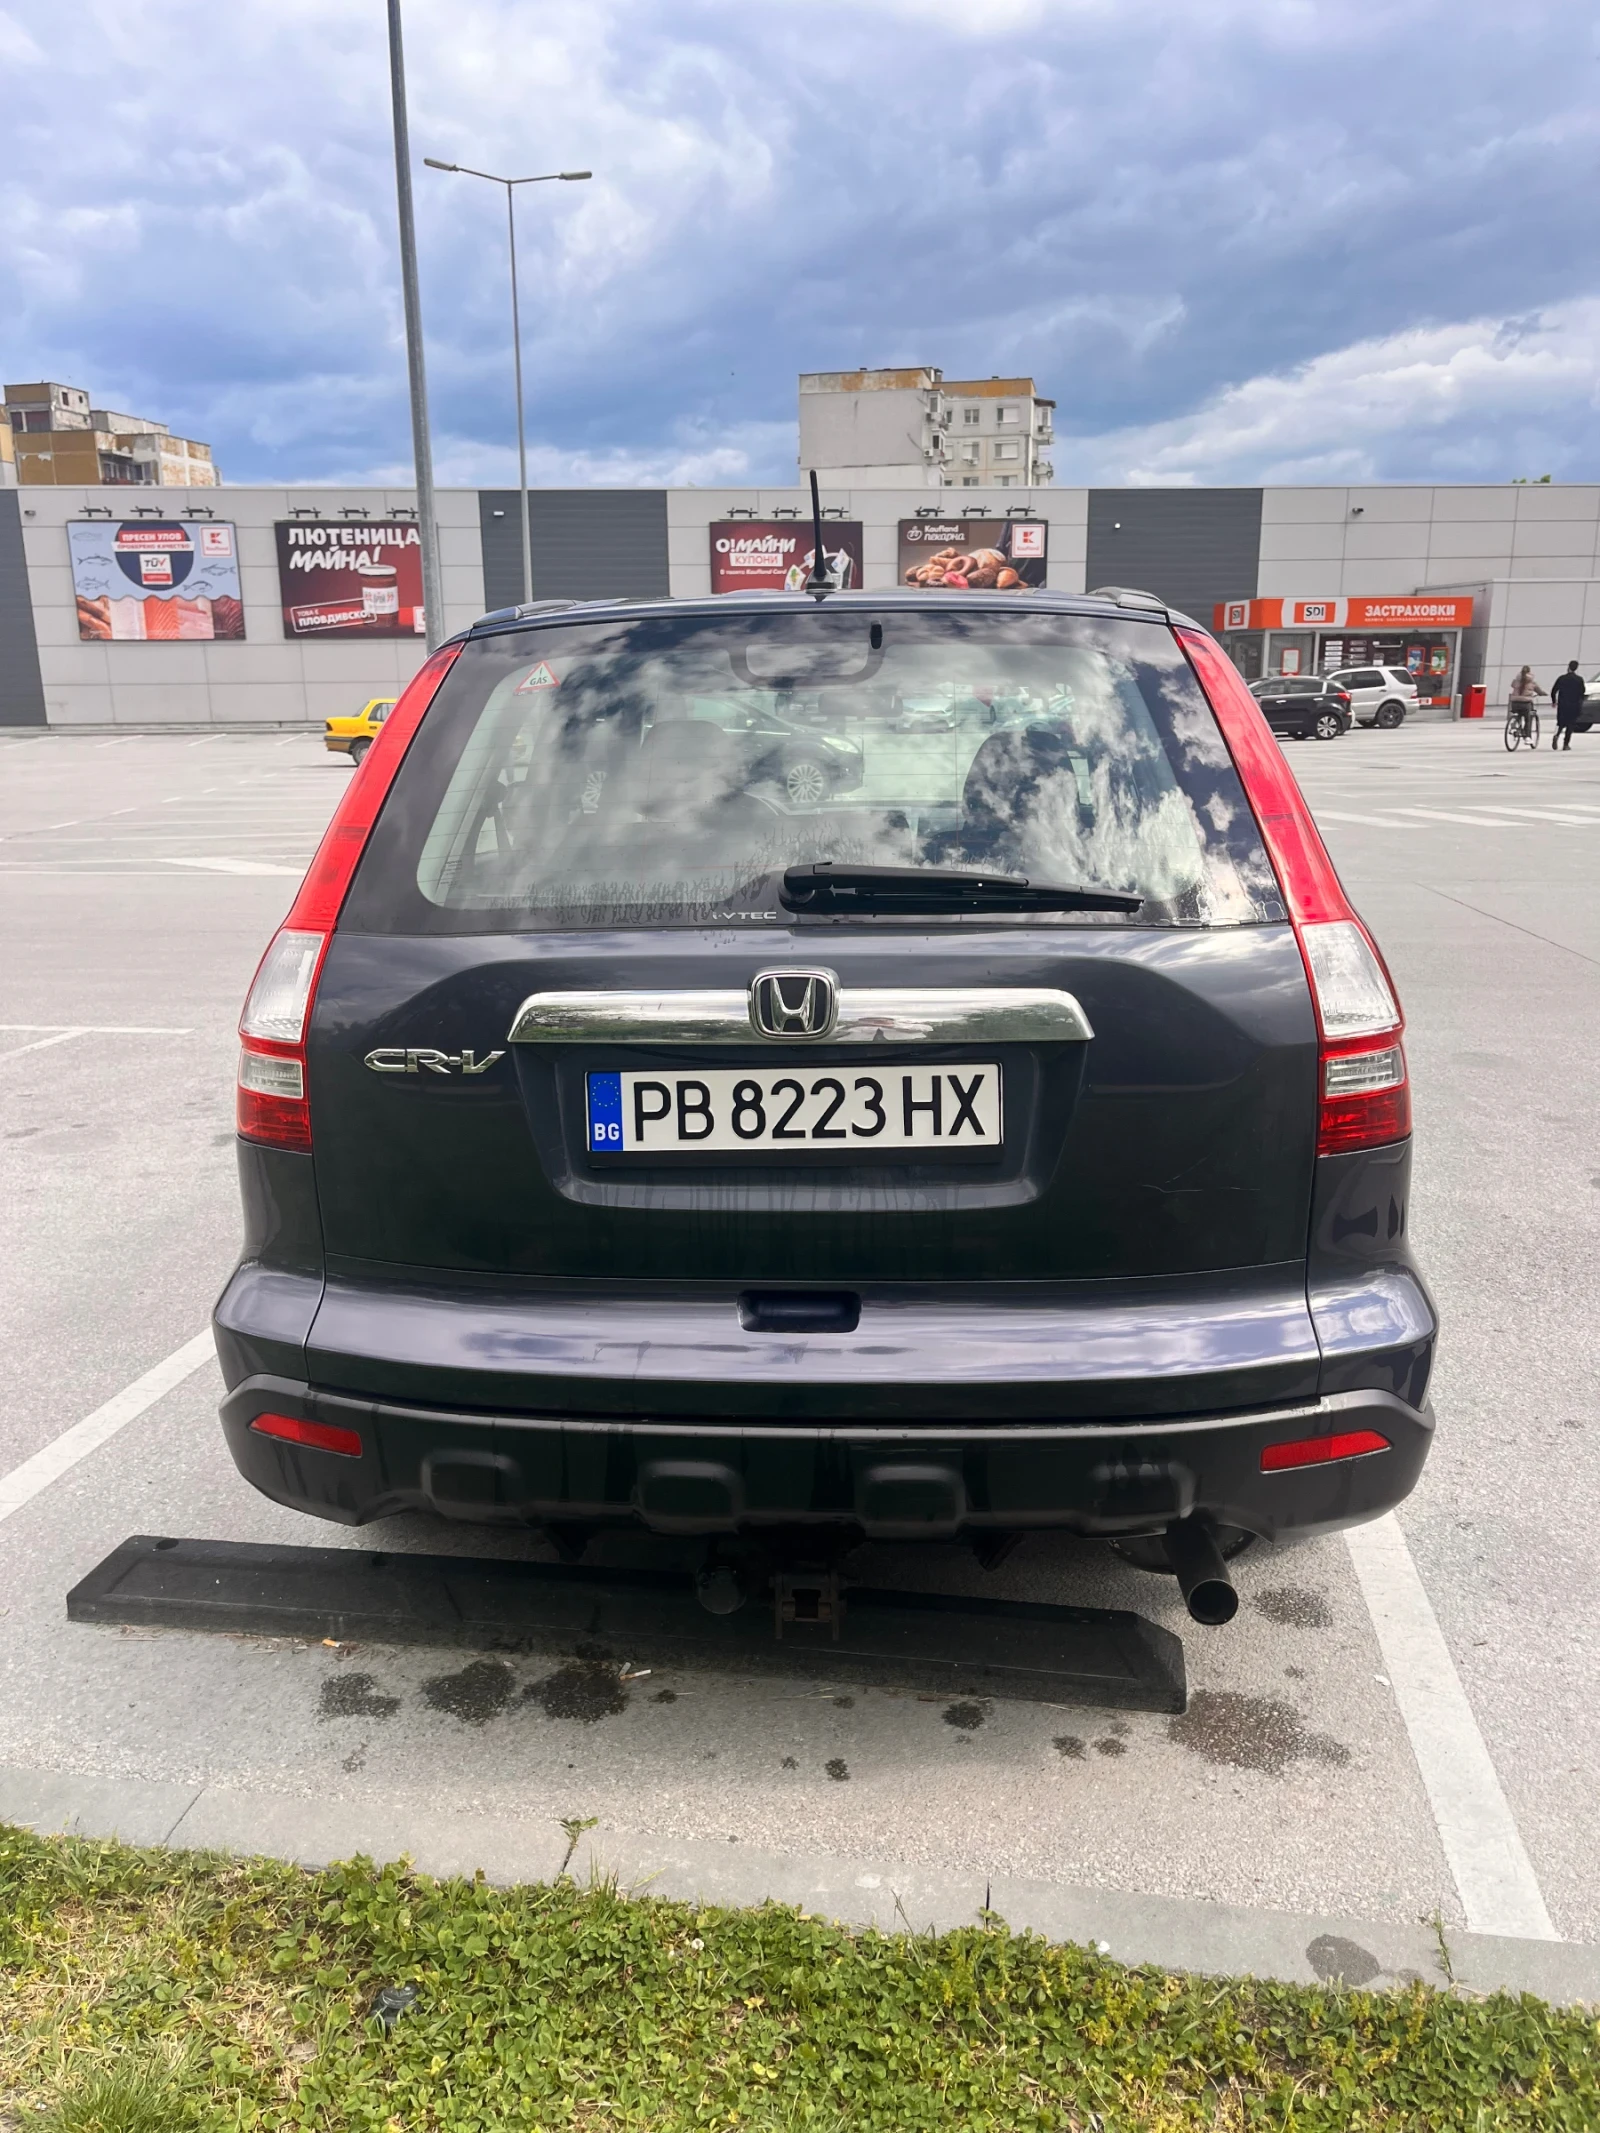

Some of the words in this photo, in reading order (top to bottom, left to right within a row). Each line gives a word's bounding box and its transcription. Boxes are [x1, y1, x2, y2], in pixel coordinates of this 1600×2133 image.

[924, 524, 960, 533] Kaufland
[121, 533, 156, 541] ПРЕСЕН
[157, 532, 182, 540] УЛОВ
[288, 528, 421, 548] ЛЮТЕНИЦА
[923, 532, 966, 542] пекарна
[144, 557, 167, 568] TÜV
[289, 545, 382, 573] МАЙНА!
[735, 555, 778, 565] КУПОНИ
[1305, 606, 1325, 617] SDI
[1364, 604, 1457, 617] ЗАСТРАХОВКИ
[529, 676, 549, 686] GAS
[363, 1048, 507, 1074] CR-V
[633, 1080, 715, 1142] PB
[731, 1076, 887, 1140] 8223
[902, 1074, 986, 1137] HX
[593, 1122, 621, 1141] BG
